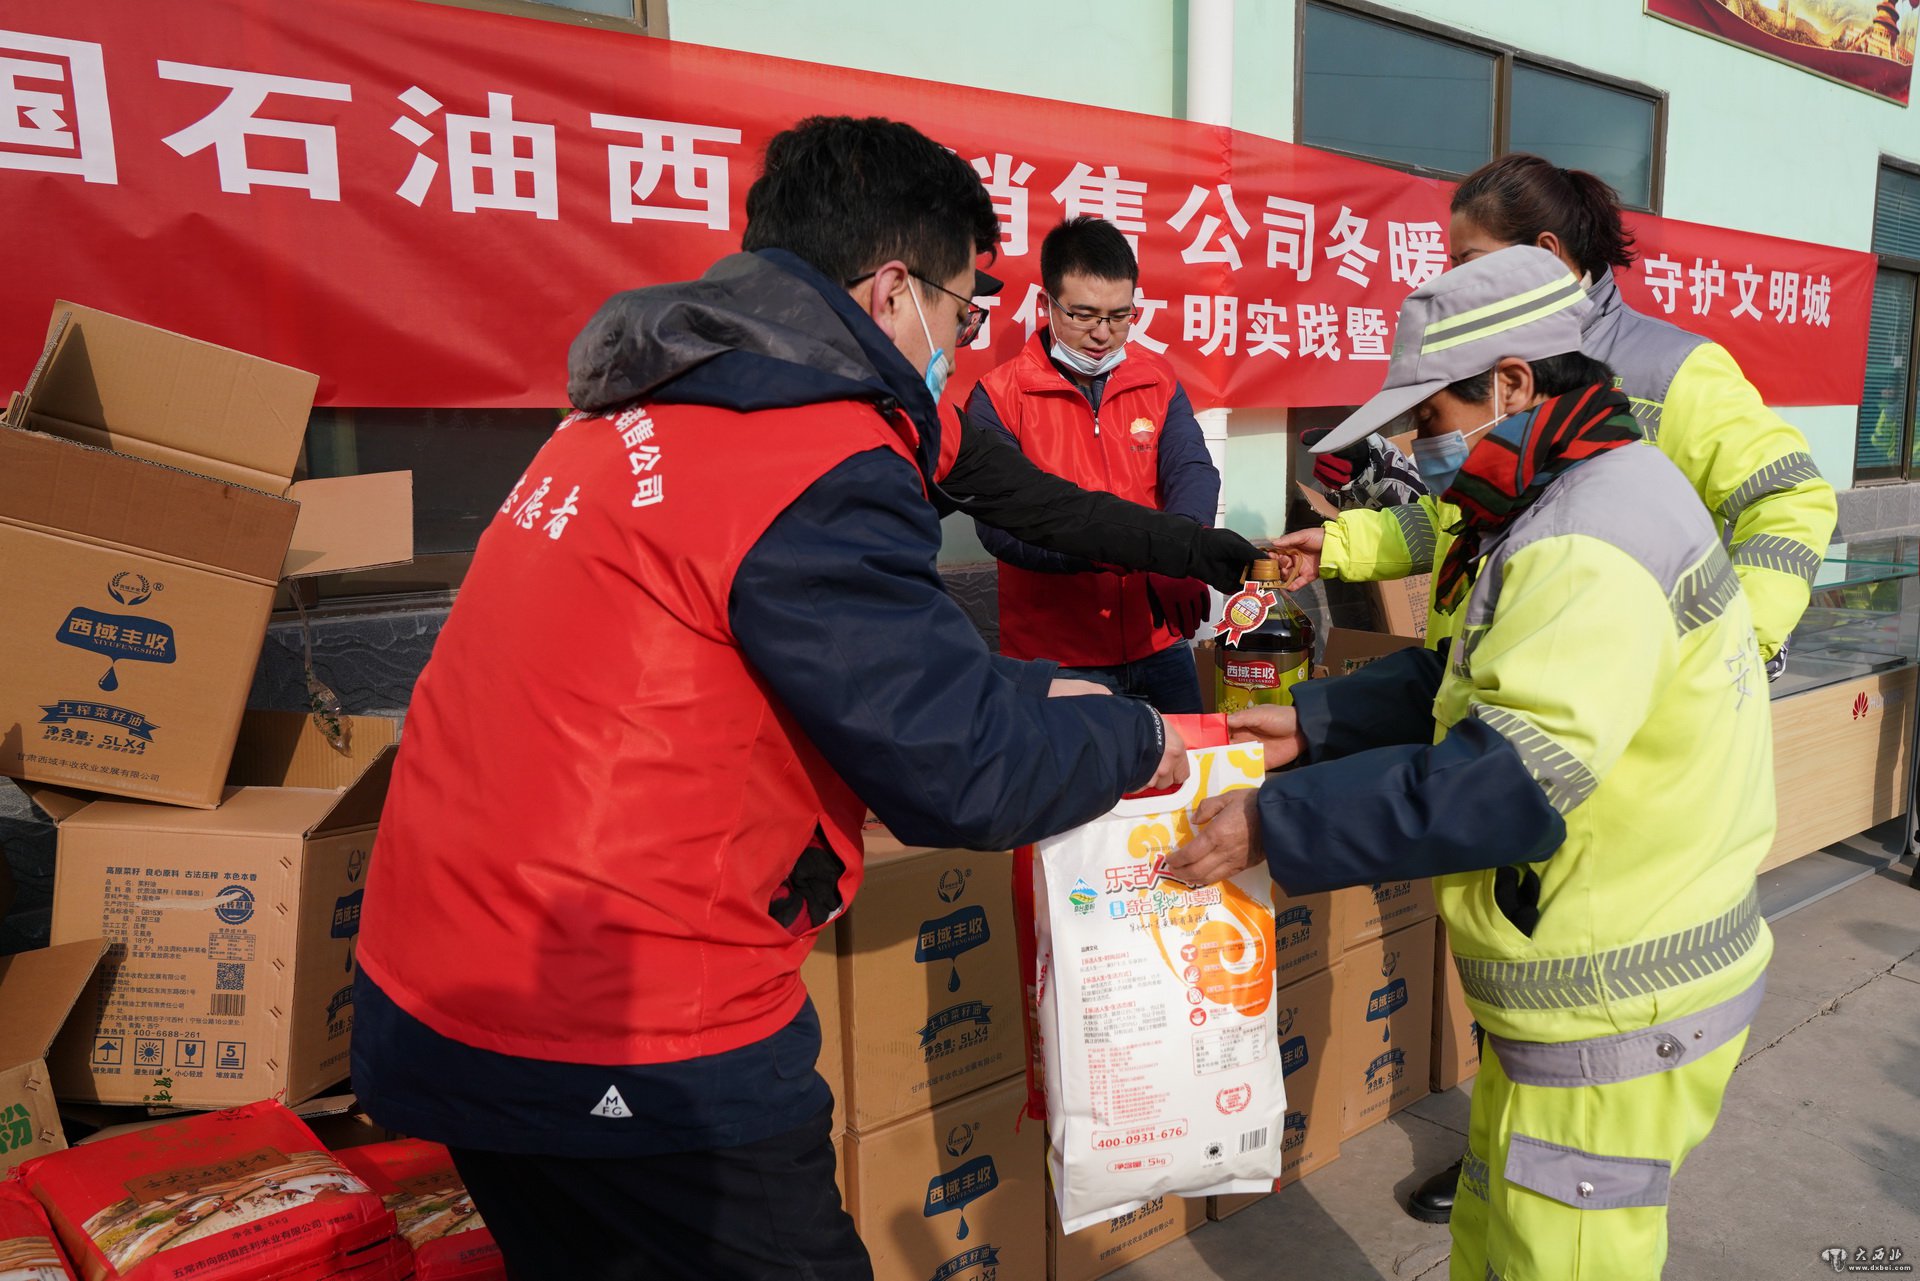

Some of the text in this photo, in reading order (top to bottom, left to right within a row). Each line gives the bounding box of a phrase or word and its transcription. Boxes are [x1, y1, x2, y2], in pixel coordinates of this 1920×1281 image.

[1644, 254, 1832, 328] 守护文明城
[68, 617, 169, 651] 西域丰收
[1226, 665, 1276, 680] 西域丰收
[59, 703, 143, 727] 土榨菜籽油
[106, 867, 140, 876] 高原菜籽
[146, 868, 179, 878] 良心原料
[185, 870, 218, 879] 古法压榨
[921, 916, 983, 950] 西域丰收
[602, 1106, 622, 1116] FG
[606, 1096, 618, 1106] M
[1098, 1127, 1183, 1149] 400-0931-676
[930, 1165, 991, 1205] 西域丰收
